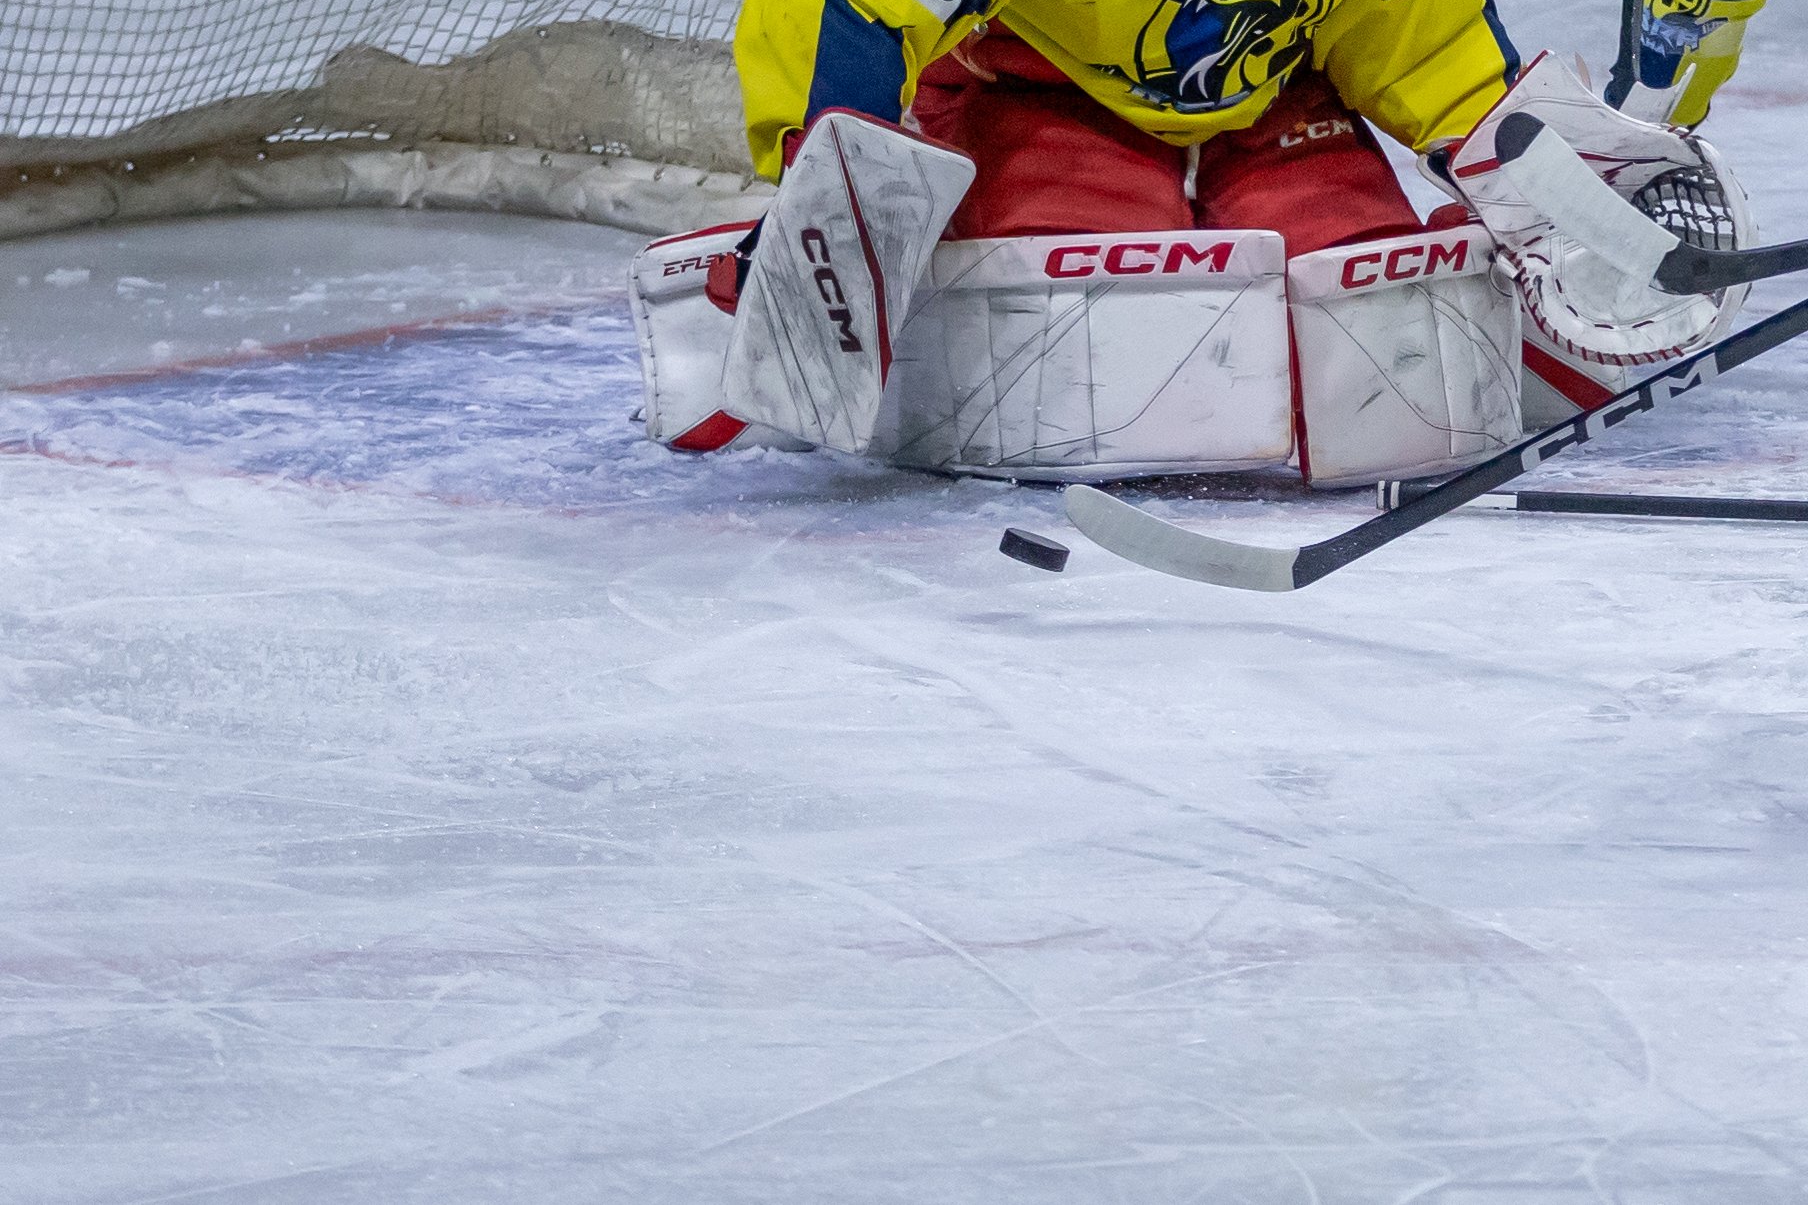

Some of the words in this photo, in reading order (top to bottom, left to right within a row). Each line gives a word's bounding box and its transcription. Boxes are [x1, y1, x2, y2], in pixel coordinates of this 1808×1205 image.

[1279, 118, 1354, 149] CCM
[663, 252, 722, 278] EFLE
[1043, 241, 1236, 280] CCM
[1339, 239, 1469, 290] CCM
[801, 225, 863, 353] CCM
[1521, 348, 1719, 472] CCM
